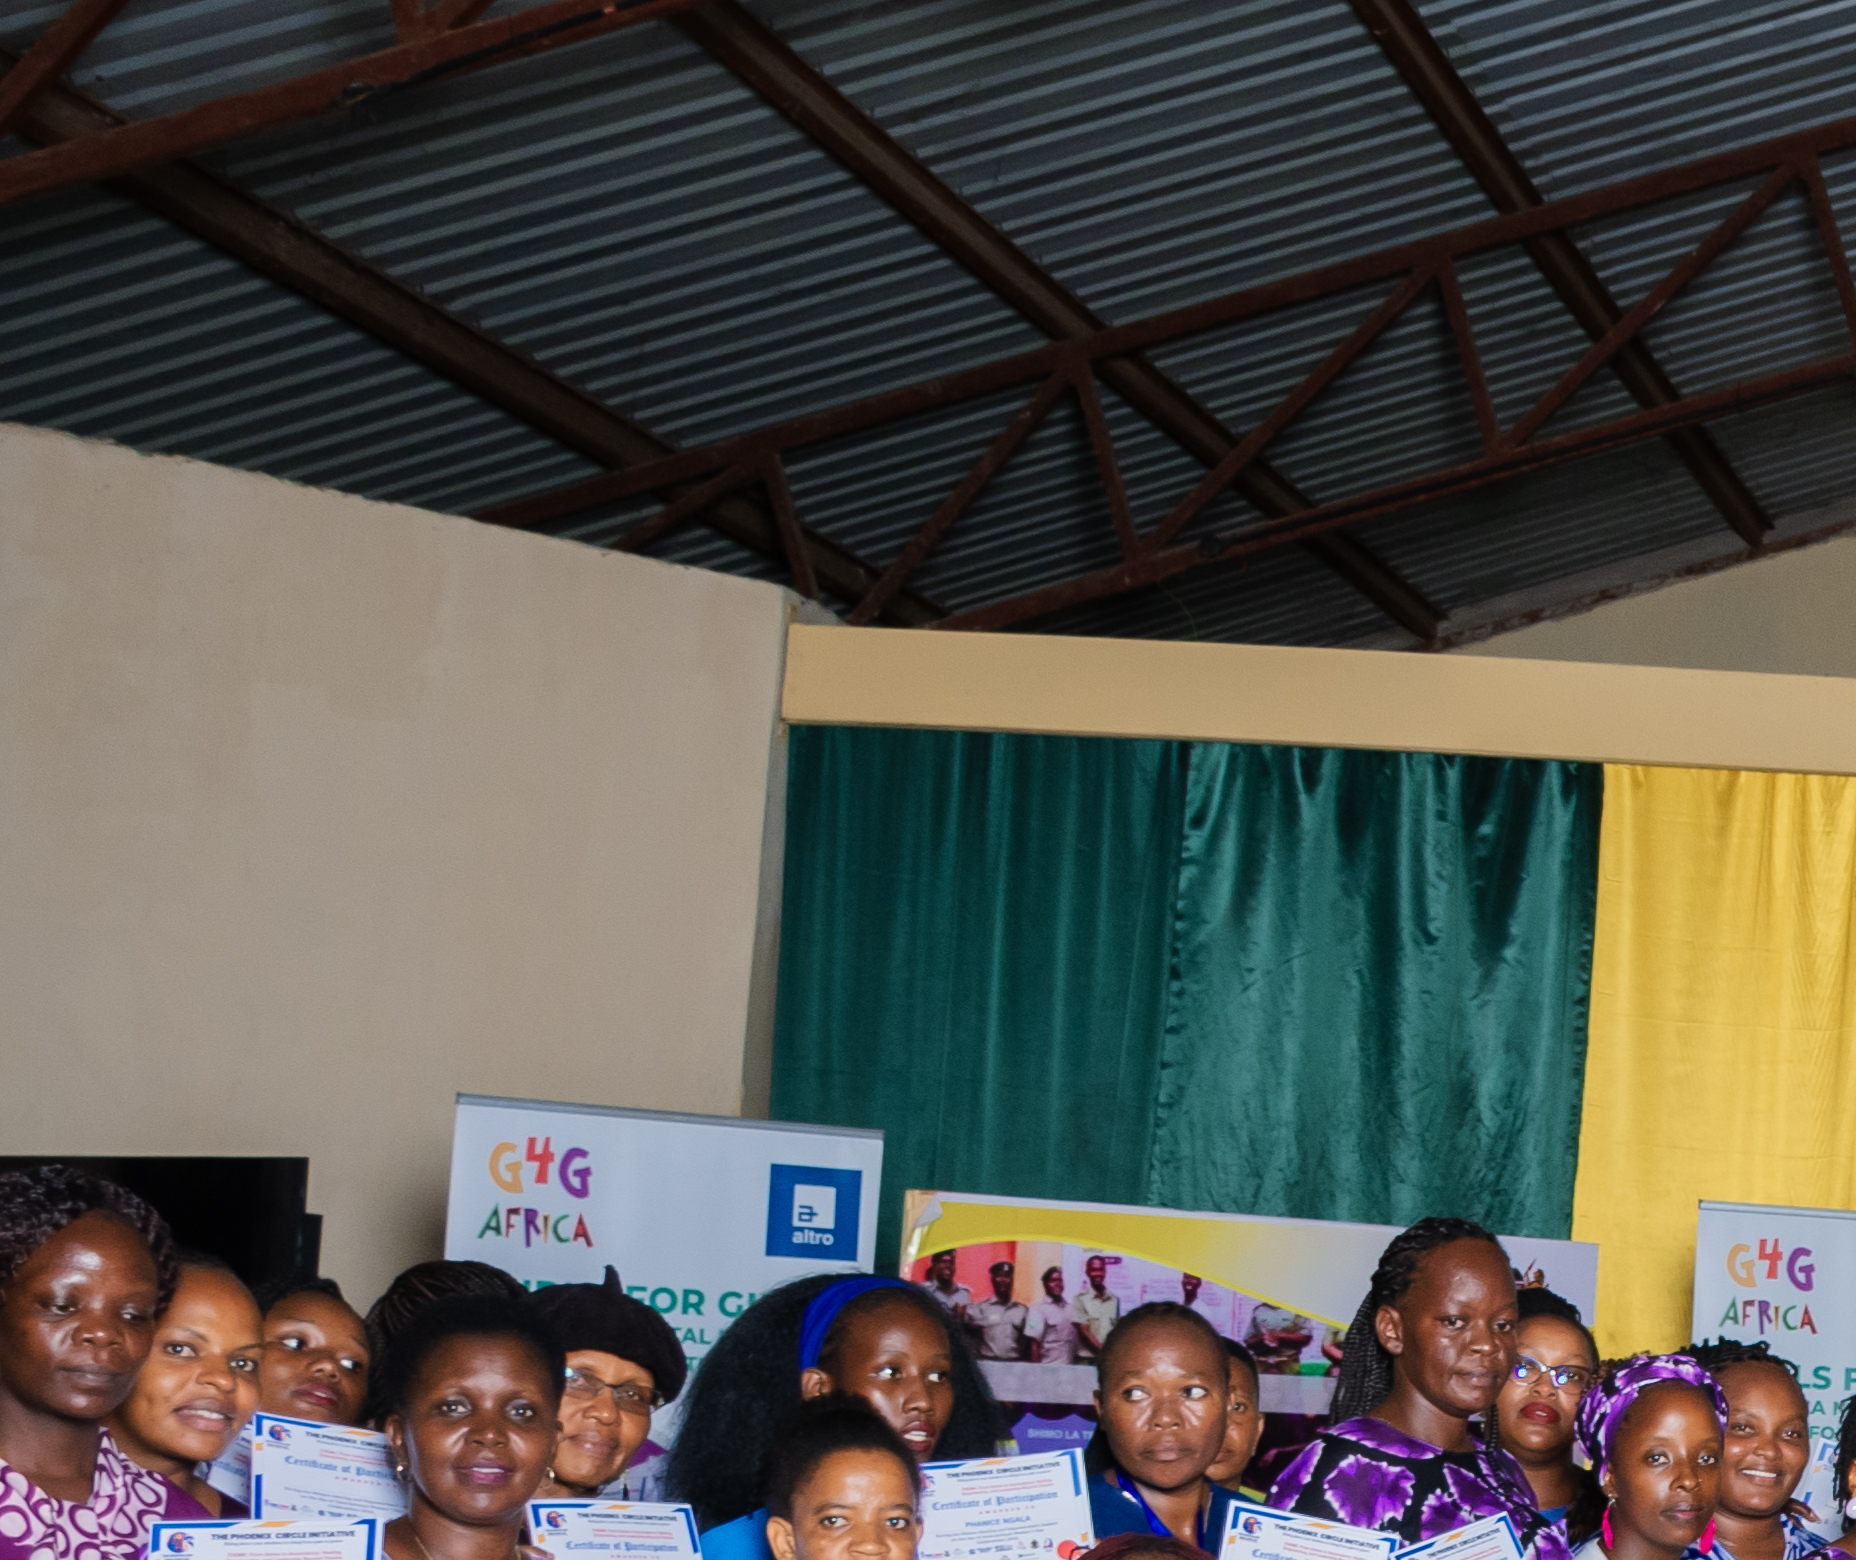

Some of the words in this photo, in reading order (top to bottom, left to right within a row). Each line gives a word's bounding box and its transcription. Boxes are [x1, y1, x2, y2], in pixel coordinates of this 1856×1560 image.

[488, 1136, 593, 1198] G4G
[477, 1203, 594, 1248] AFRICA
[791, 1229, 834, 1245] altro
[1725, 1238, 1815, 1292] G4G
[625, 1285, 704, 1317] FOR
[1718, 1295, 1818, 1335] AFRICA
